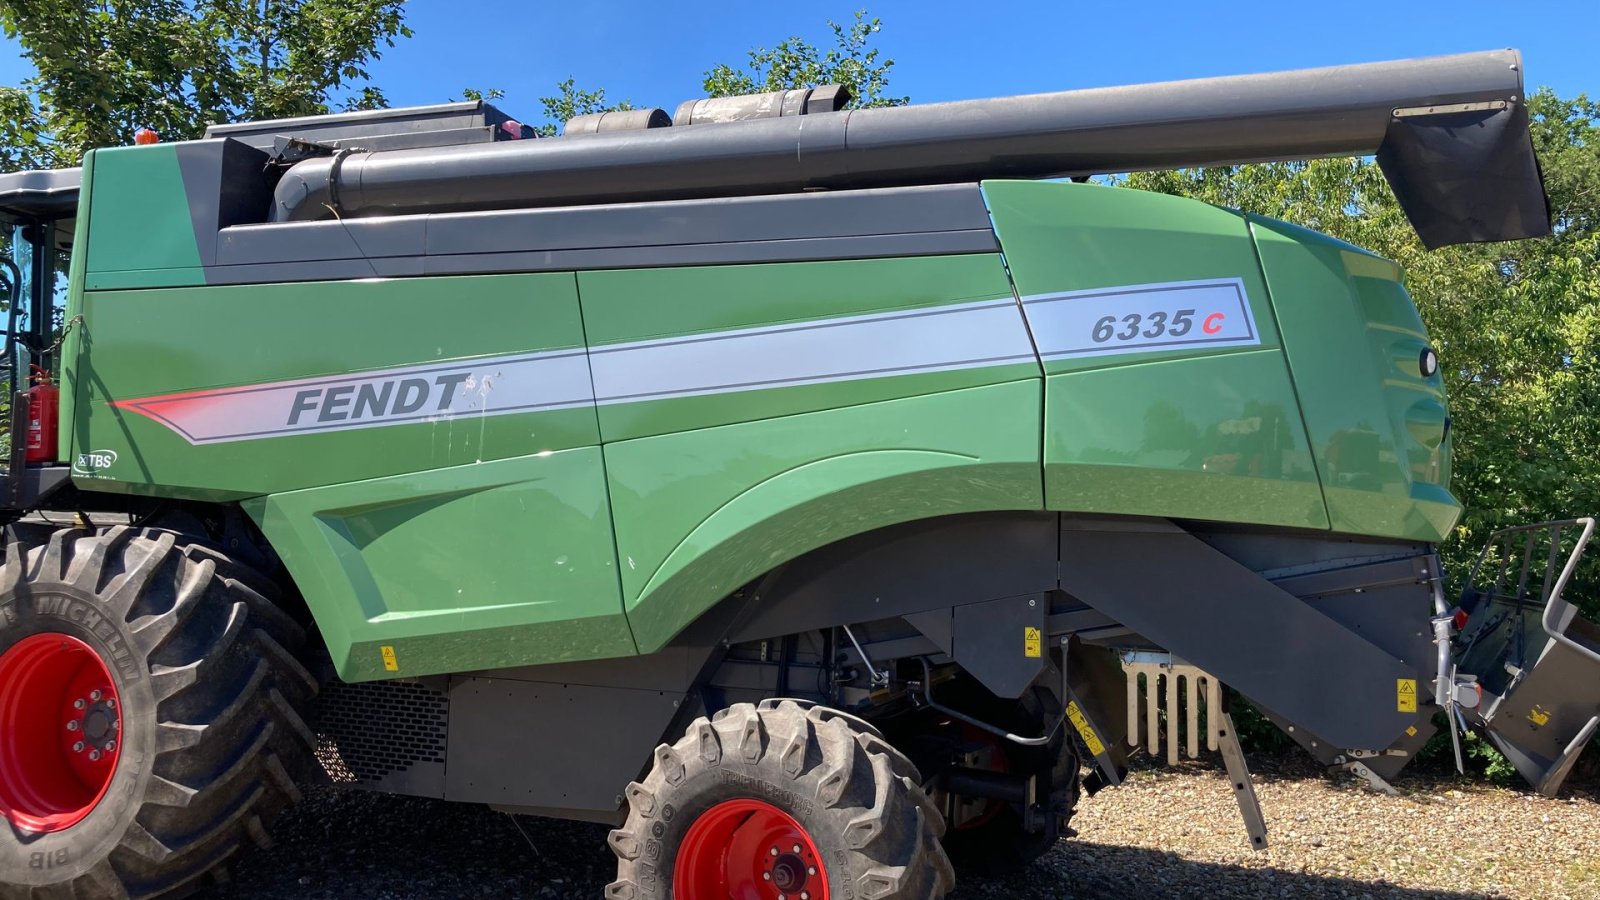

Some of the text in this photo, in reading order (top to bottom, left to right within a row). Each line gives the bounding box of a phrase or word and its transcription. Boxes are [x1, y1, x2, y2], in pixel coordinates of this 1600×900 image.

[1091, 308, 1196, 343] 6335
[286, 372, 472, 425] FENDT
[88, 454, 112, 469] TBS
[37, 595, 140, 682] MICHELIN
[720, 767, 814, 816] TRELLEBORG
